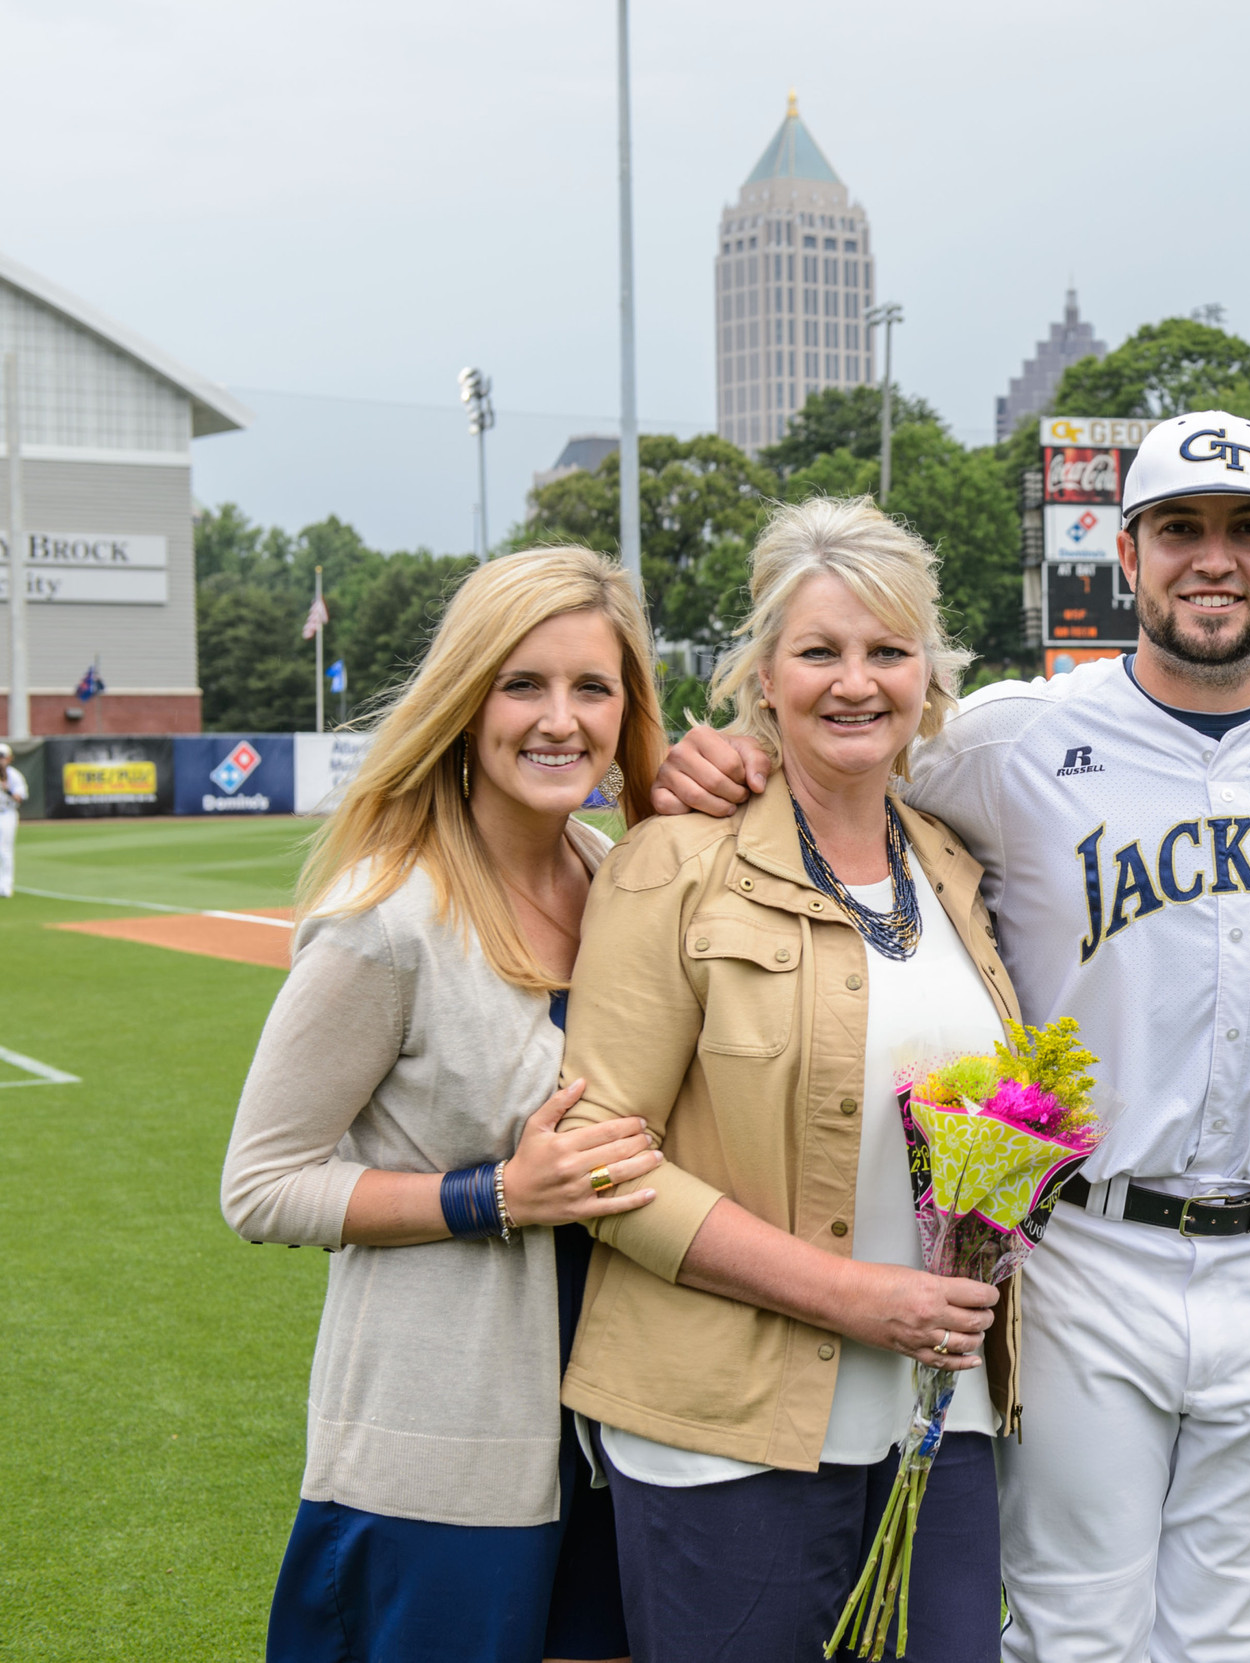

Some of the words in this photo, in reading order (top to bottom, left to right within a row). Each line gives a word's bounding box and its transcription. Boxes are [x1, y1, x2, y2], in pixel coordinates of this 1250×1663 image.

[1090, 421, 1150, 446] GEO
[29, 534, 128, 562] BROCK
[1057, 765, 1105, 776] RUSSELL
[202, 794, 269, 811] Domino's
